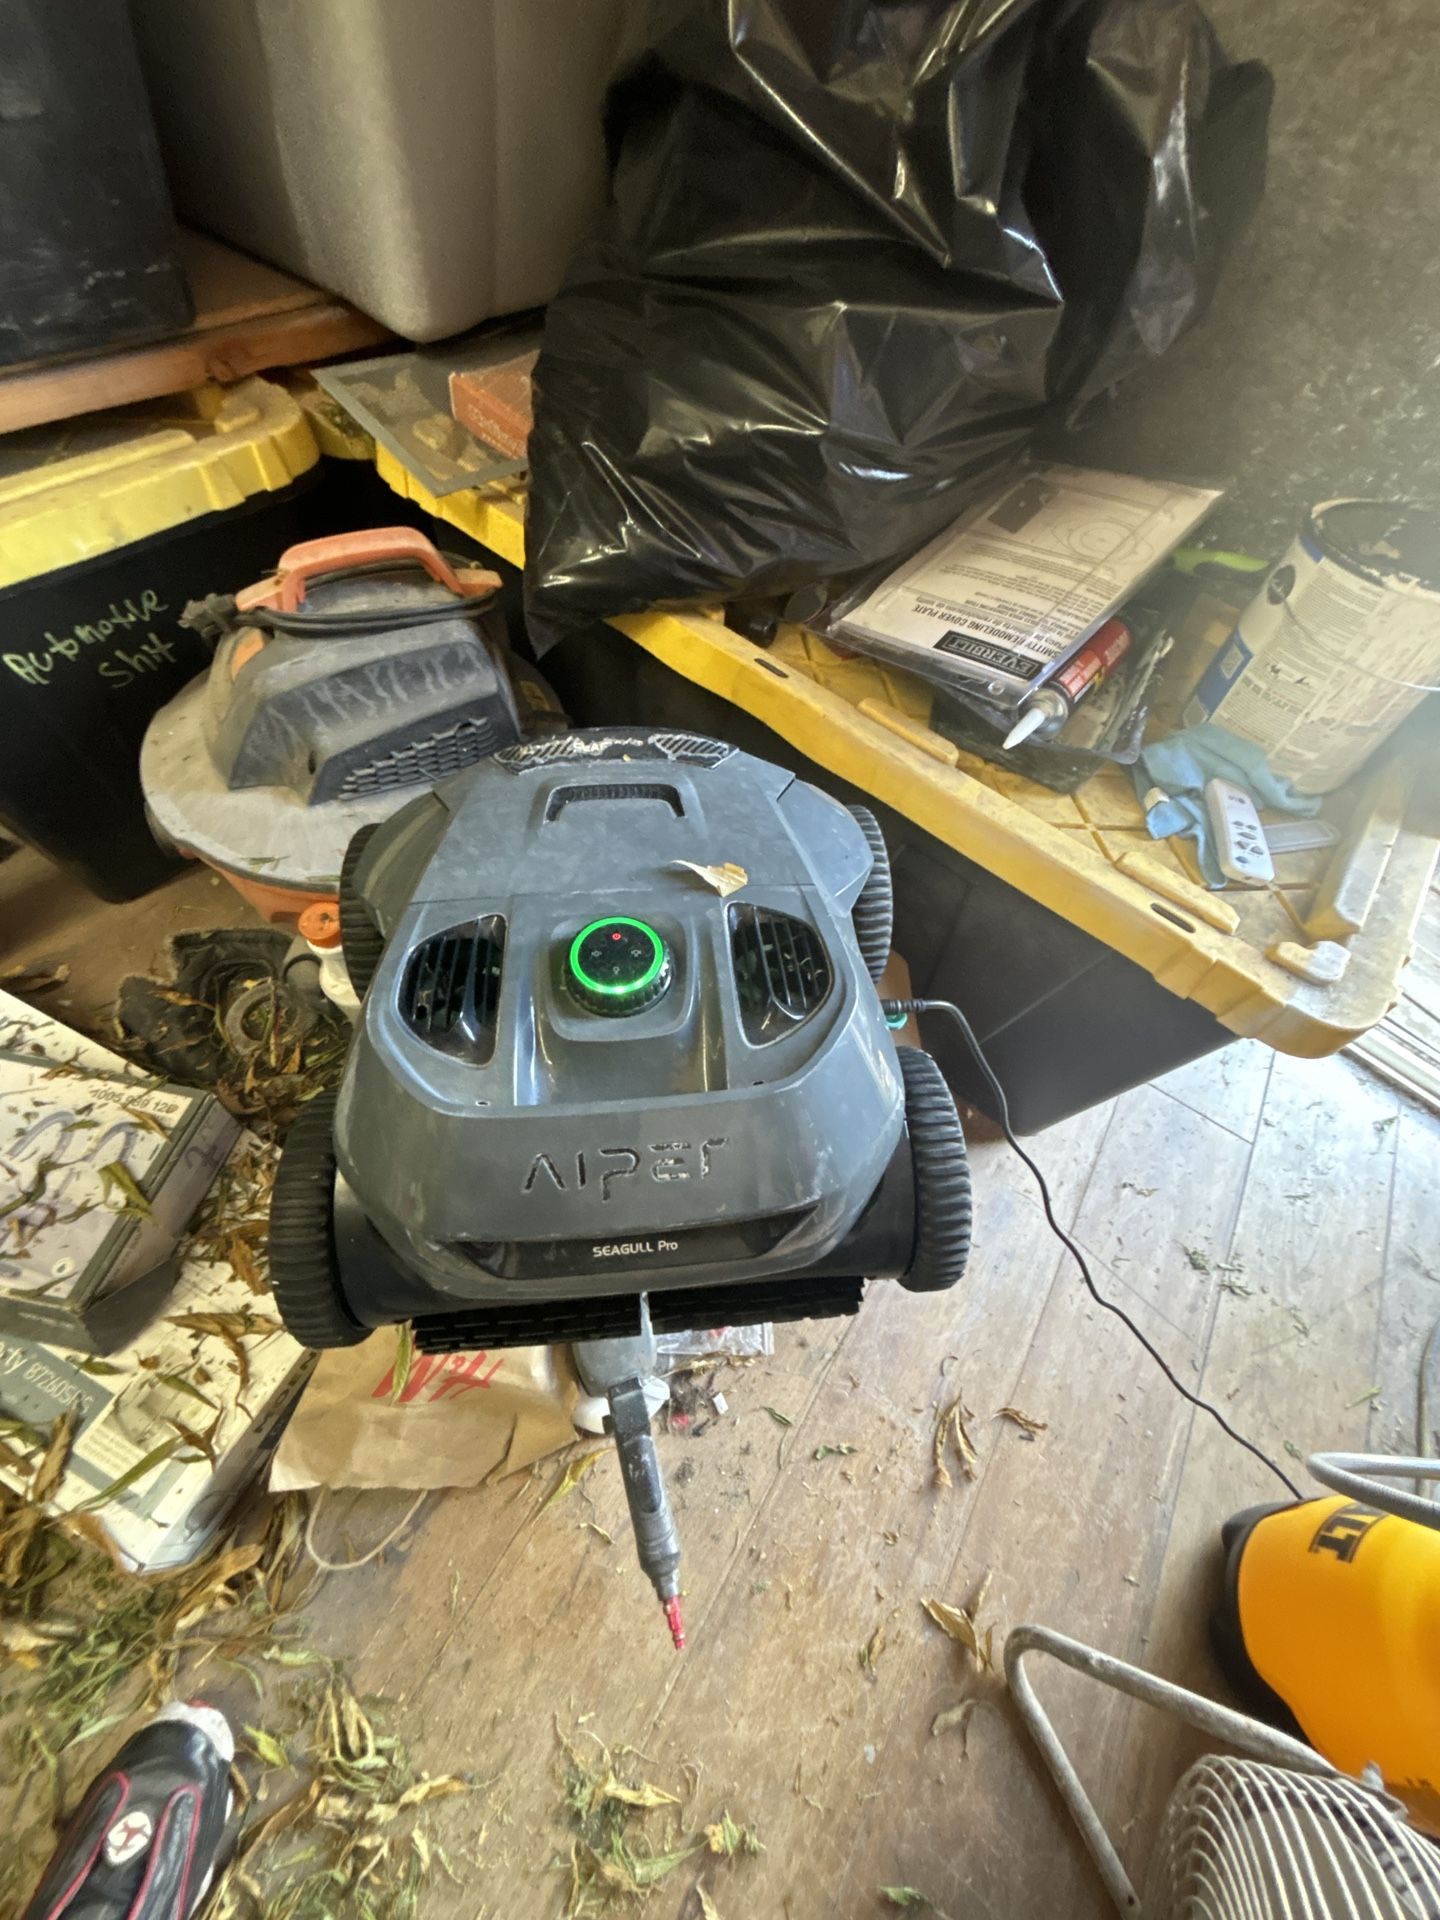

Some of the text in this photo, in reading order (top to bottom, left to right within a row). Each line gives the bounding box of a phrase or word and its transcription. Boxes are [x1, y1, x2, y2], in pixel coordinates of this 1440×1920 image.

[912, 604, 937, 618] PLATE
[938, 612, 968, 627] COVER
[967, 621, 1026, 648] REMODELING
[949, 638, 1034, 675] EVERBILT
[592, 1239, 678, 1258] SEAGULL Pro
